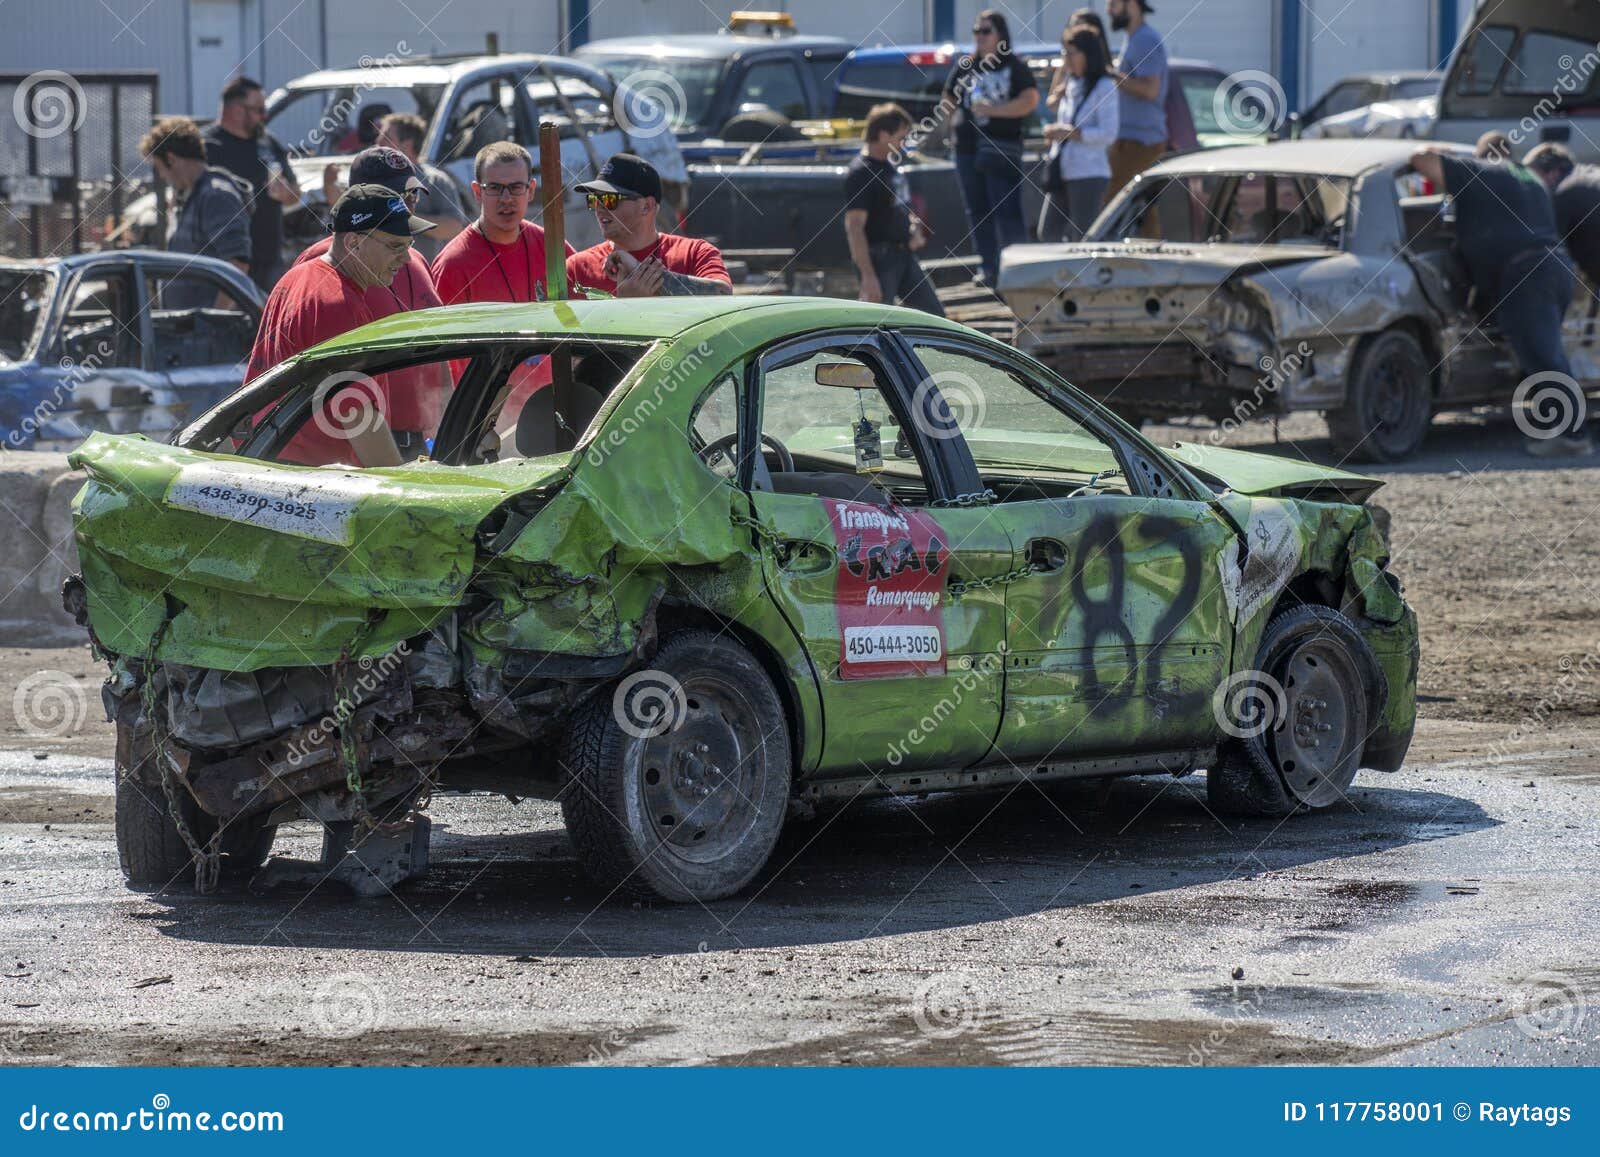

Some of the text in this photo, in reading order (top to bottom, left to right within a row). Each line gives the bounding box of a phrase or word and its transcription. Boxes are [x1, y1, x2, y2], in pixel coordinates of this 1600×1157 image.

[199, 486, 317, 520] 438-390-3925
[866, 585, 941, 613] Remorquage
[849, 635, 938, 656] 450-444-3050
